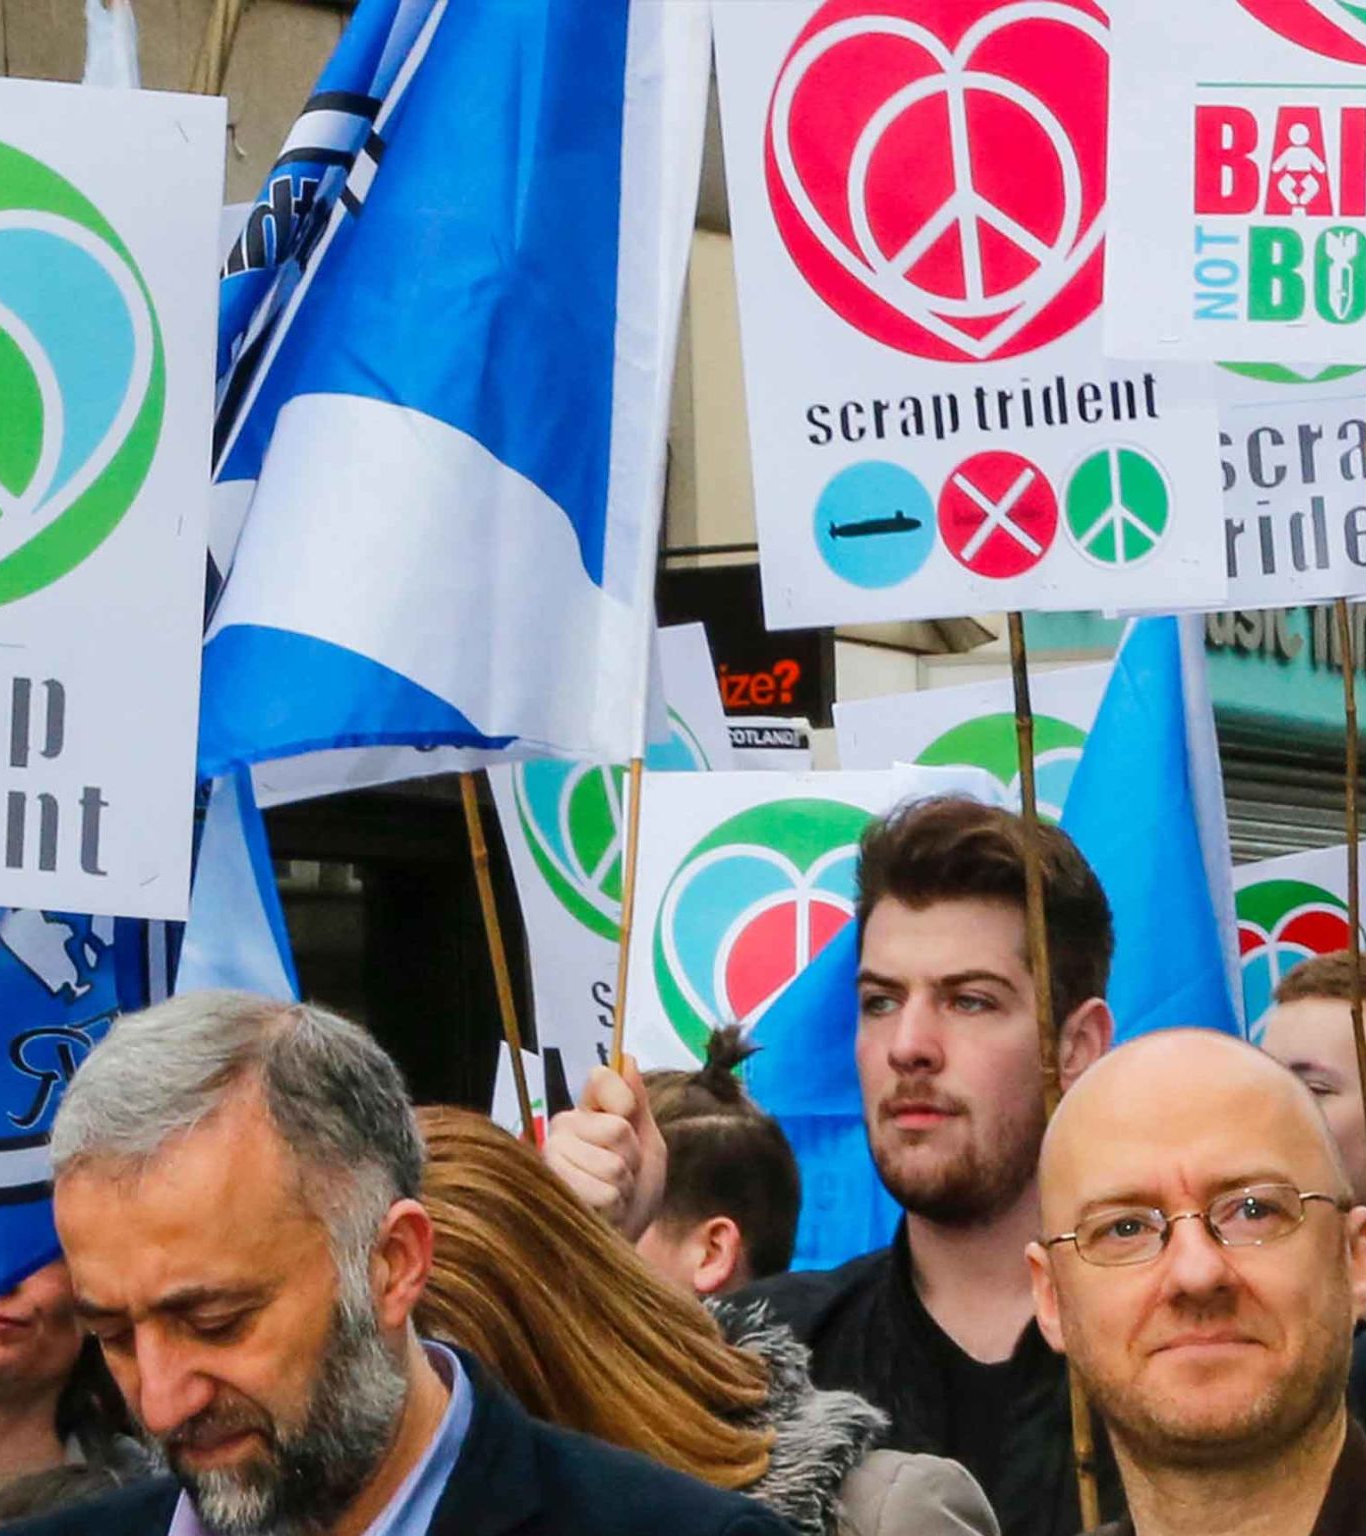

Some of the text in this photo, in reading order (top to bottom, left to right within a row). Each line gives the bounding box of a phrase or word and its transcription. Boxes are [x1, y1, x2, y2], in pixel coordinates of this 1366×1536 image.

[1193, 225, 1240, 321] NOT
[806, 373, 1160, 446] scrap trident
